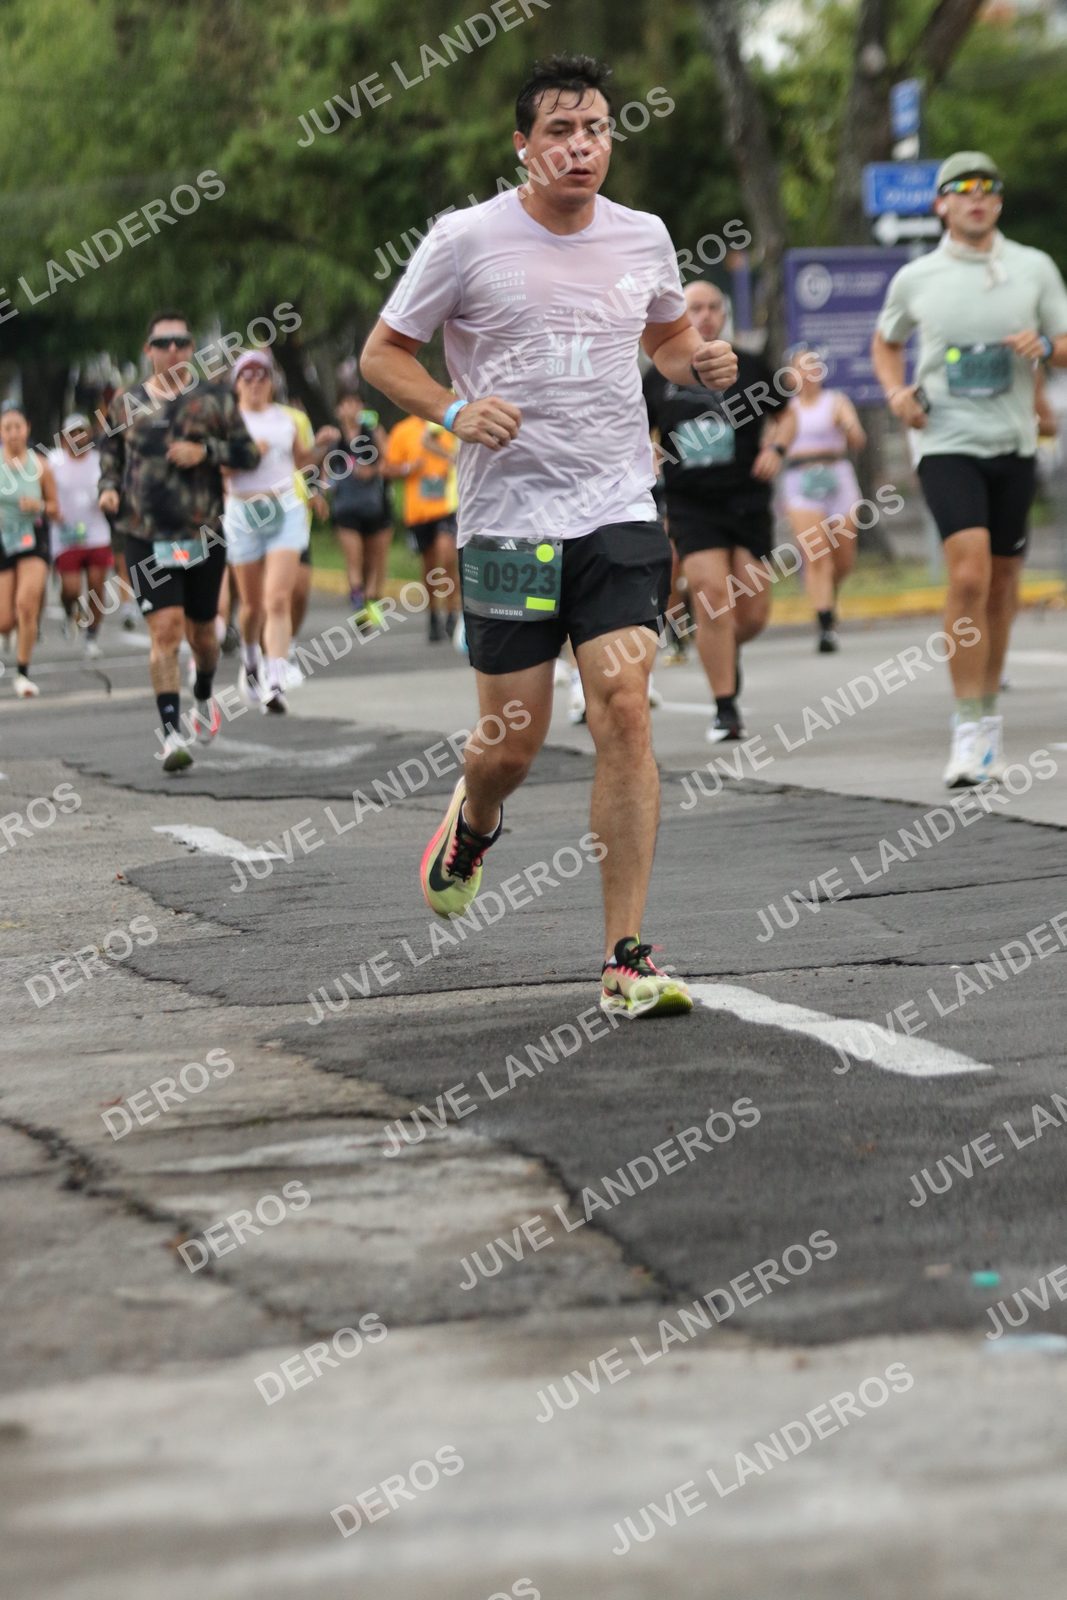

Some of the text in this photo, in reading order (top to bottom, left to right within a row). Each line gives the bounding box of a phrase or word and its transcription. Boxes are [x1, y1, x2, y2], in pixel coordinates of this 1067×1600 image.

[545, 358, 565, 376] 30
[570, 335, 596, 377] K
[483, 561, 556, 595] 0923
[489, 608, 523, 617] SAMSUNG
